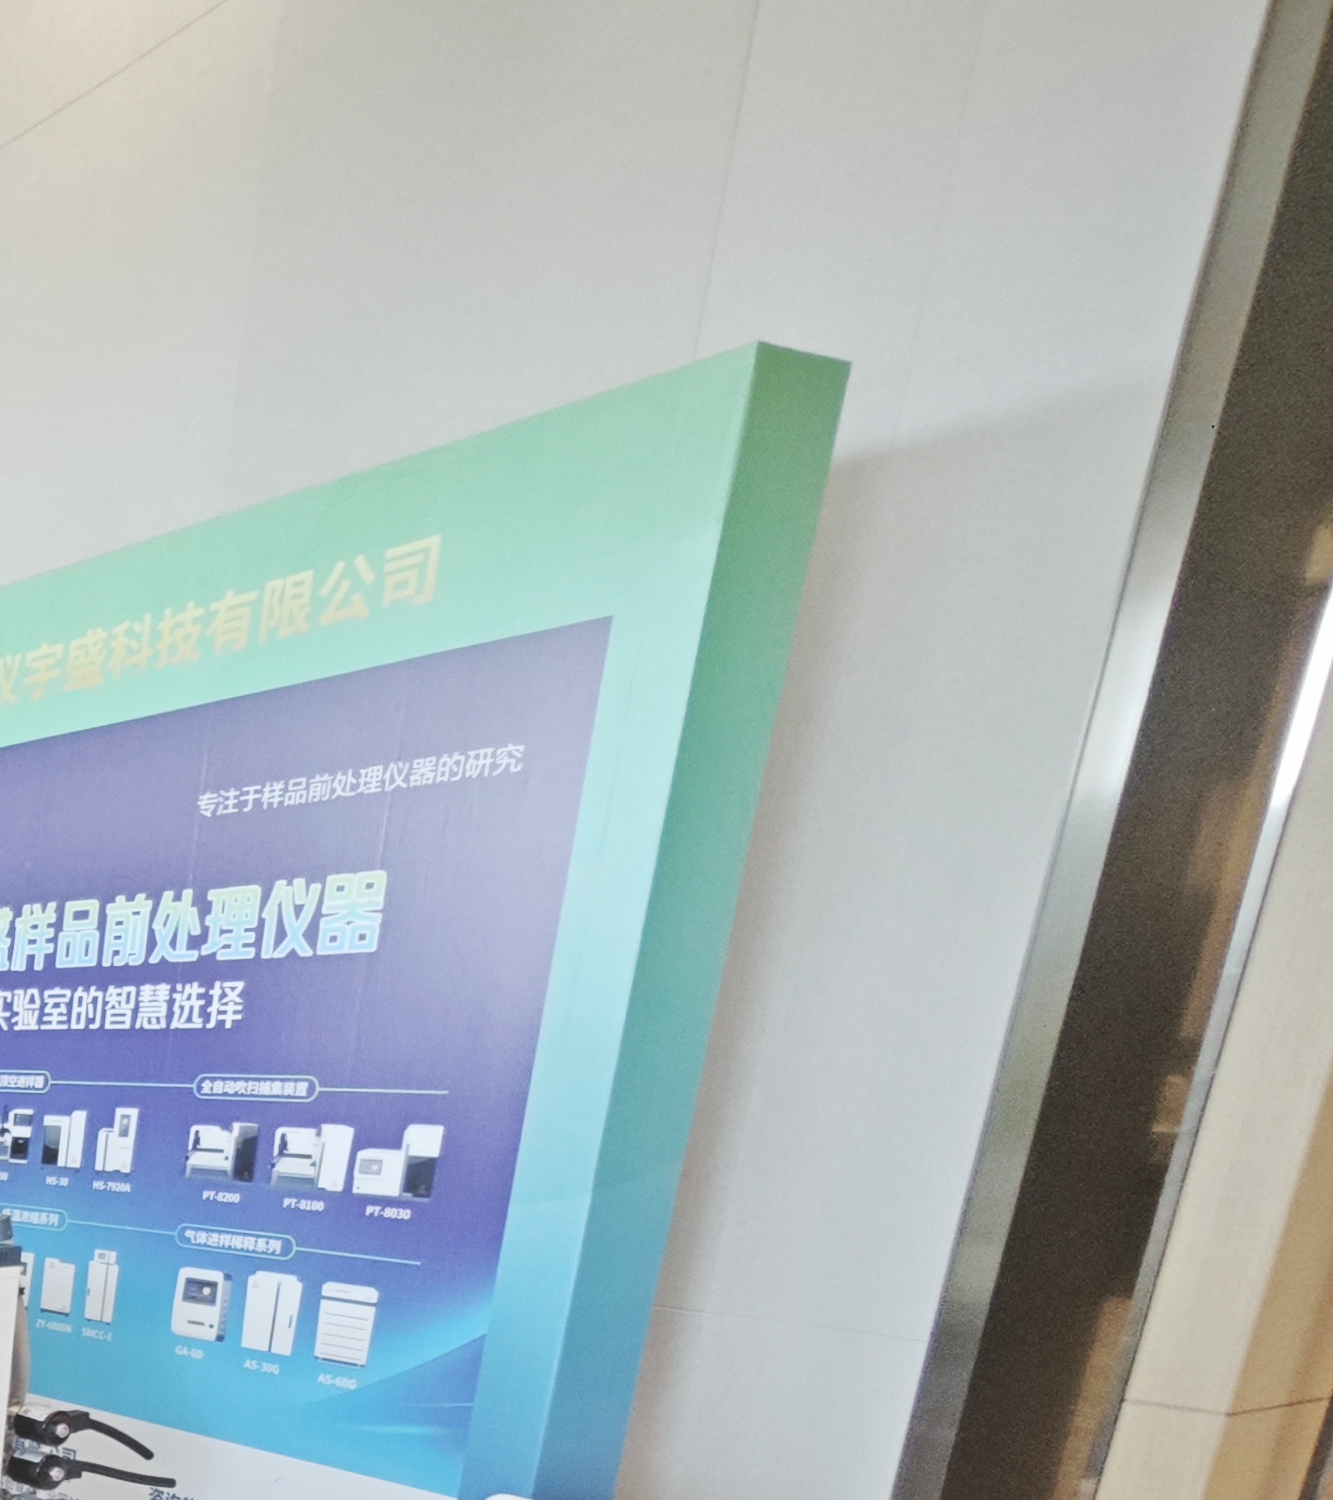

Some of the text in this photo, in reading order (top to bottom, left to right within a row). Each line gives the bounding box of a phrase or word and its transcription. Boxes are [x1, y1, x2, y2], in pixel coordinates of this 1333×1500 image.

[197, 744, 524, 817] 专注于样品前处理仪器的研究
[283, 1198, 325, 1212] PT-8100
[365, 1205, 411, 1220] PT-8030
